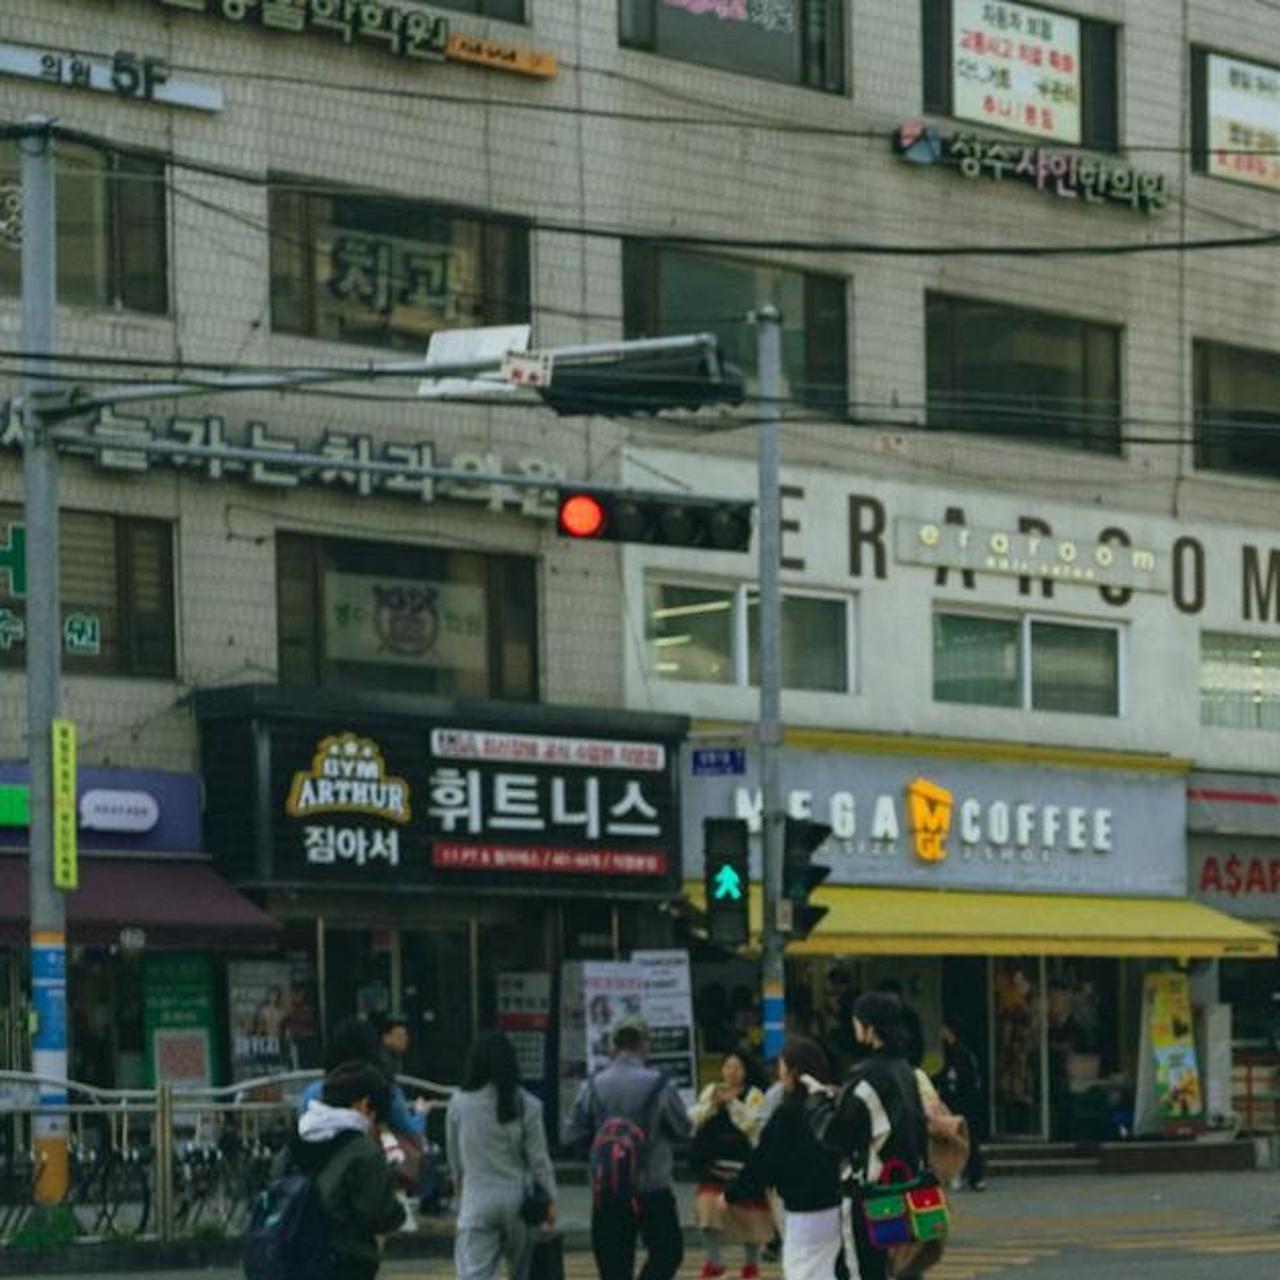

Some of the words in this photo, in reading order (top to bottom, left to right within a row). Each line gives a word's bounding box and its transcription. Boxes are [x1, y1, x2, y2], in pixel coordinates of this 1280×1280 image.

[919, 524, 1156, 572] eraroom
[323, 757, 379, 779] GYM
[298, 778, 405, 816] ARTHUR
[428, 768, 662, 839] 휘트니스
[733, 787, 900, 841] MEGA
[303, 824, 400, 867] 짐아서
[960, 797, 1113, 853] COFFEE
